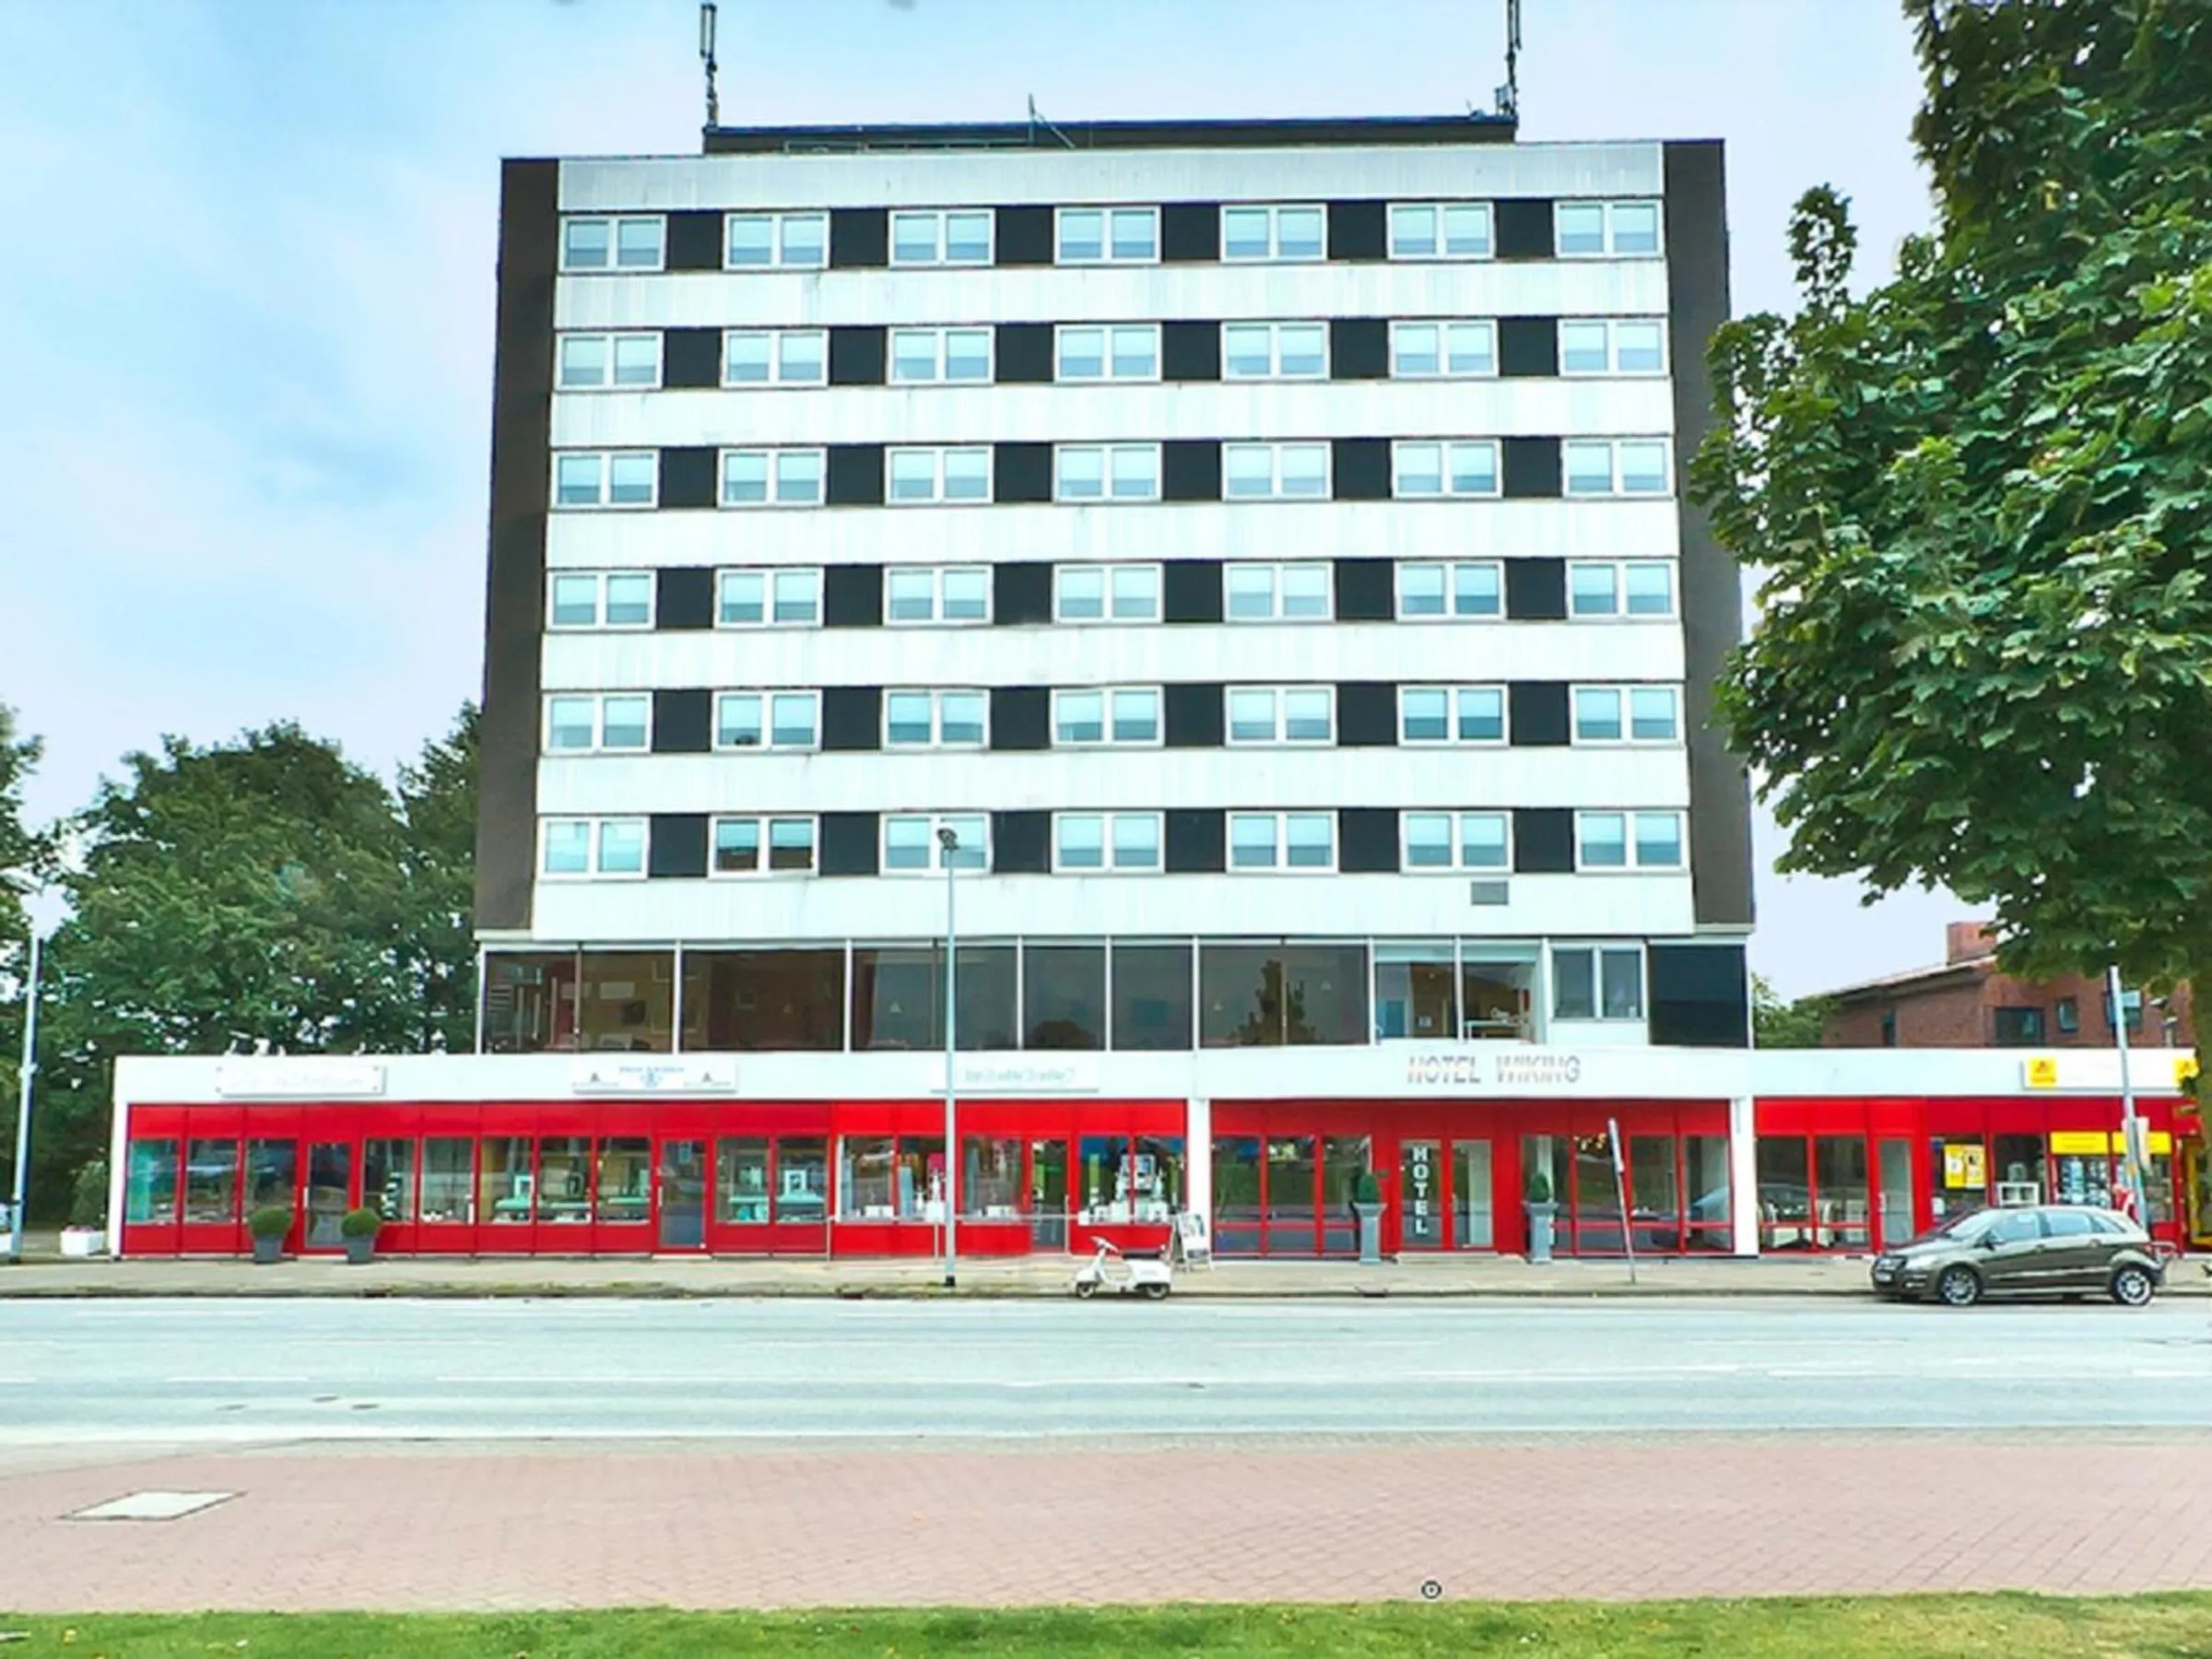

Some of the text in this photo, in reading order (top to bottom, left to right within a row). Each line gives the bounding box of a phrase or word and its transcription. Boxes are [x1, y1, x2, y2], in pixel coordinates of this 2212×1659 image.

[1407, 1055, 1582, 1084] HOTEL WIKING
[1413, 1146, 1429, 1235] HOTEL
